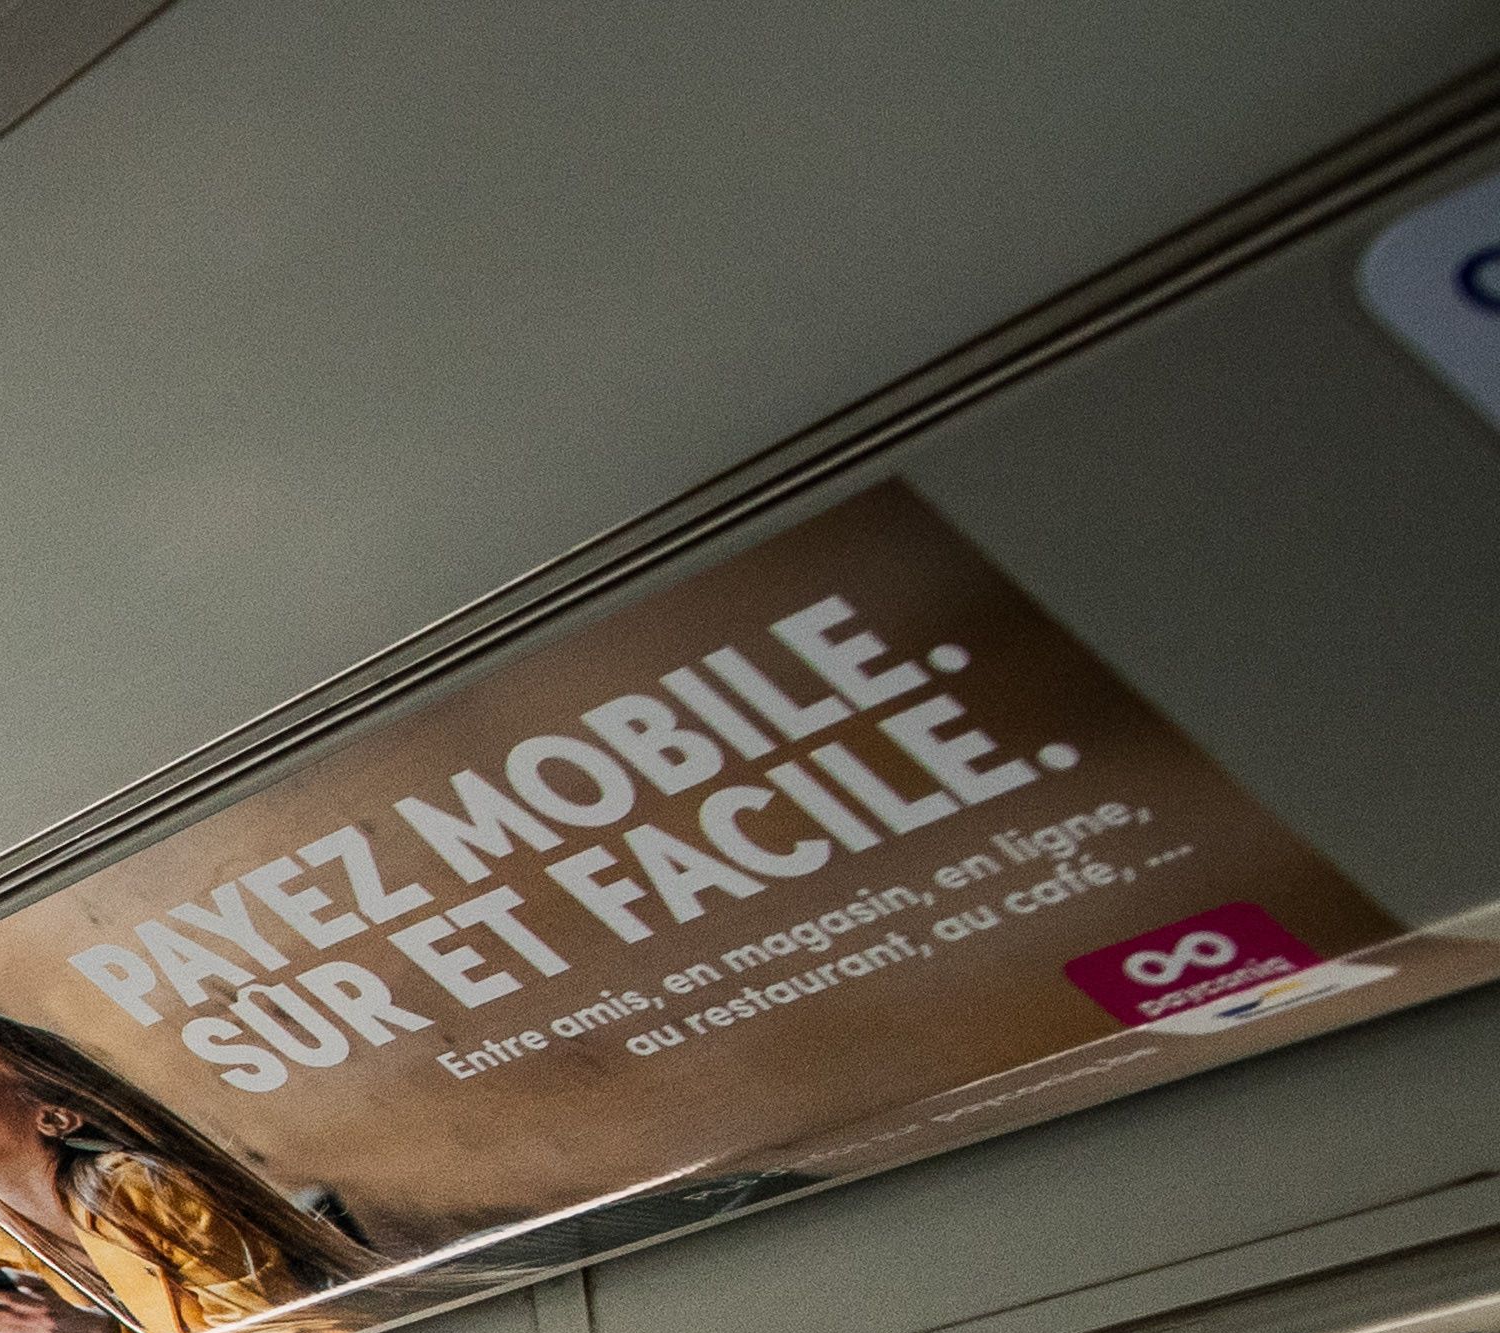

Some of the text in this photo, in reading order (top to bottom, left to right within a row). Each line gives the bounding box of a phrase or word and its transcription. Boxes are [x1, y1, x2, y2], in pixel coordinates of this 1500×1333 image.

[66, 594, 970, 1028] PAYEZ MOBILE.
[180, 694, 1081, 1094] SÛR ET FACILE.
[435, 800, 1153, 1081] Entre amis, en magasin, en ligne,
[625, 1018, 687, 1057] au
[684, 930, 935, 1034] restaurant,
[932, 904, 1000, 943] au
[1003, 850, 1137, 915] café,
